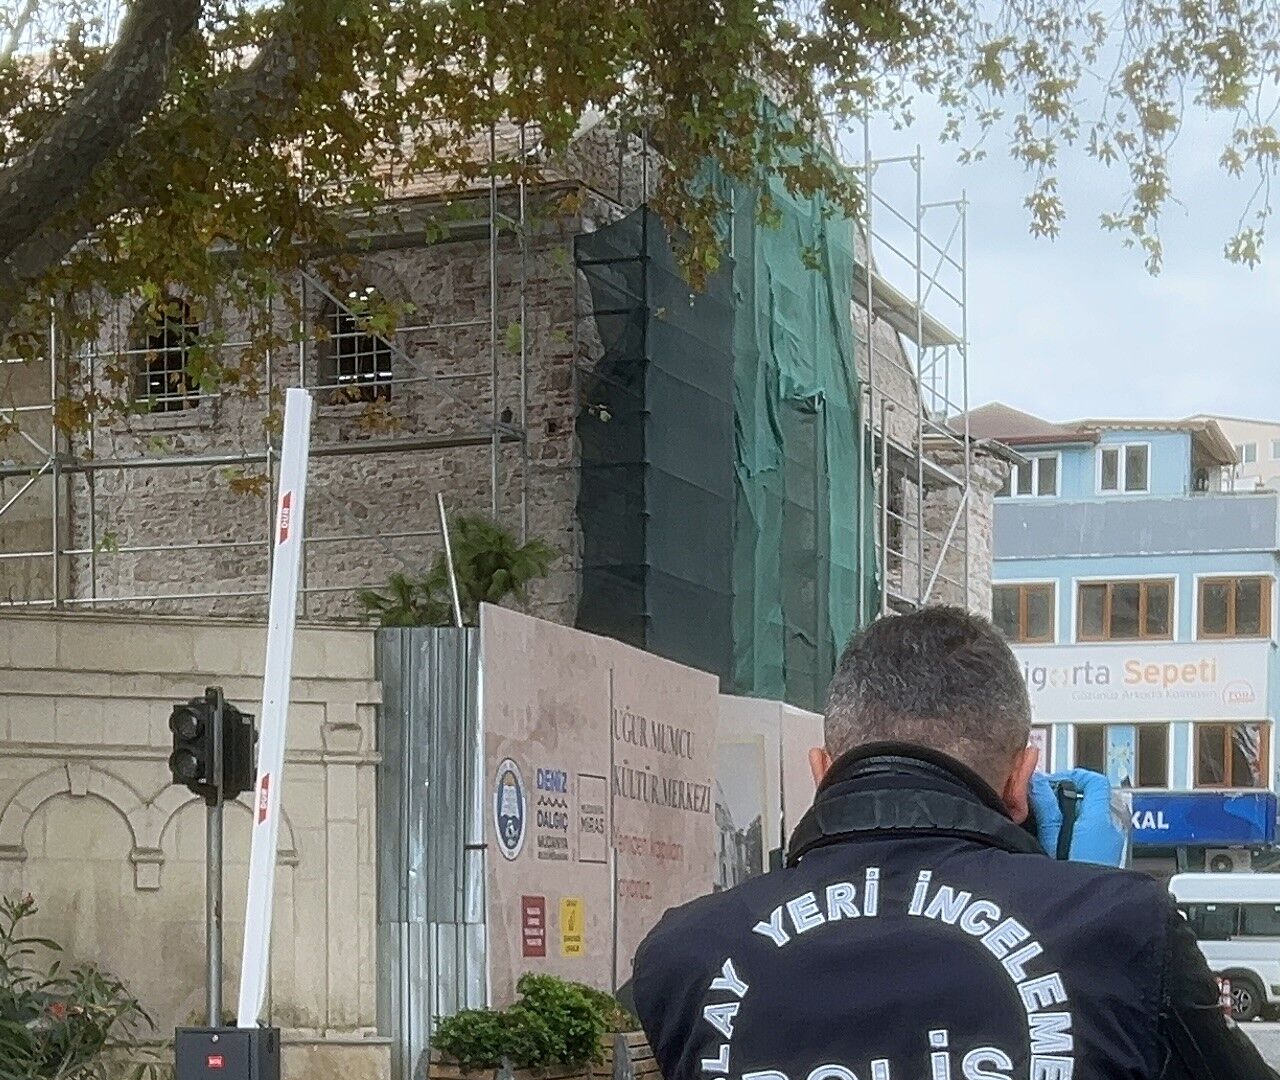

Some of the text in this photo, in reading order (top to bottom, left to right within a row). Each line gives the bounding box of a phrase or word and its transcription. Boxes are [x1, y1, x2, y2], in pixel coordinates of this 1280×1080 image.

[1025, 657, 1217, 692] igorta Sepeti
[1131, 810, 1170, 830] KAL
[752, 867, 880, 947] YERİ
